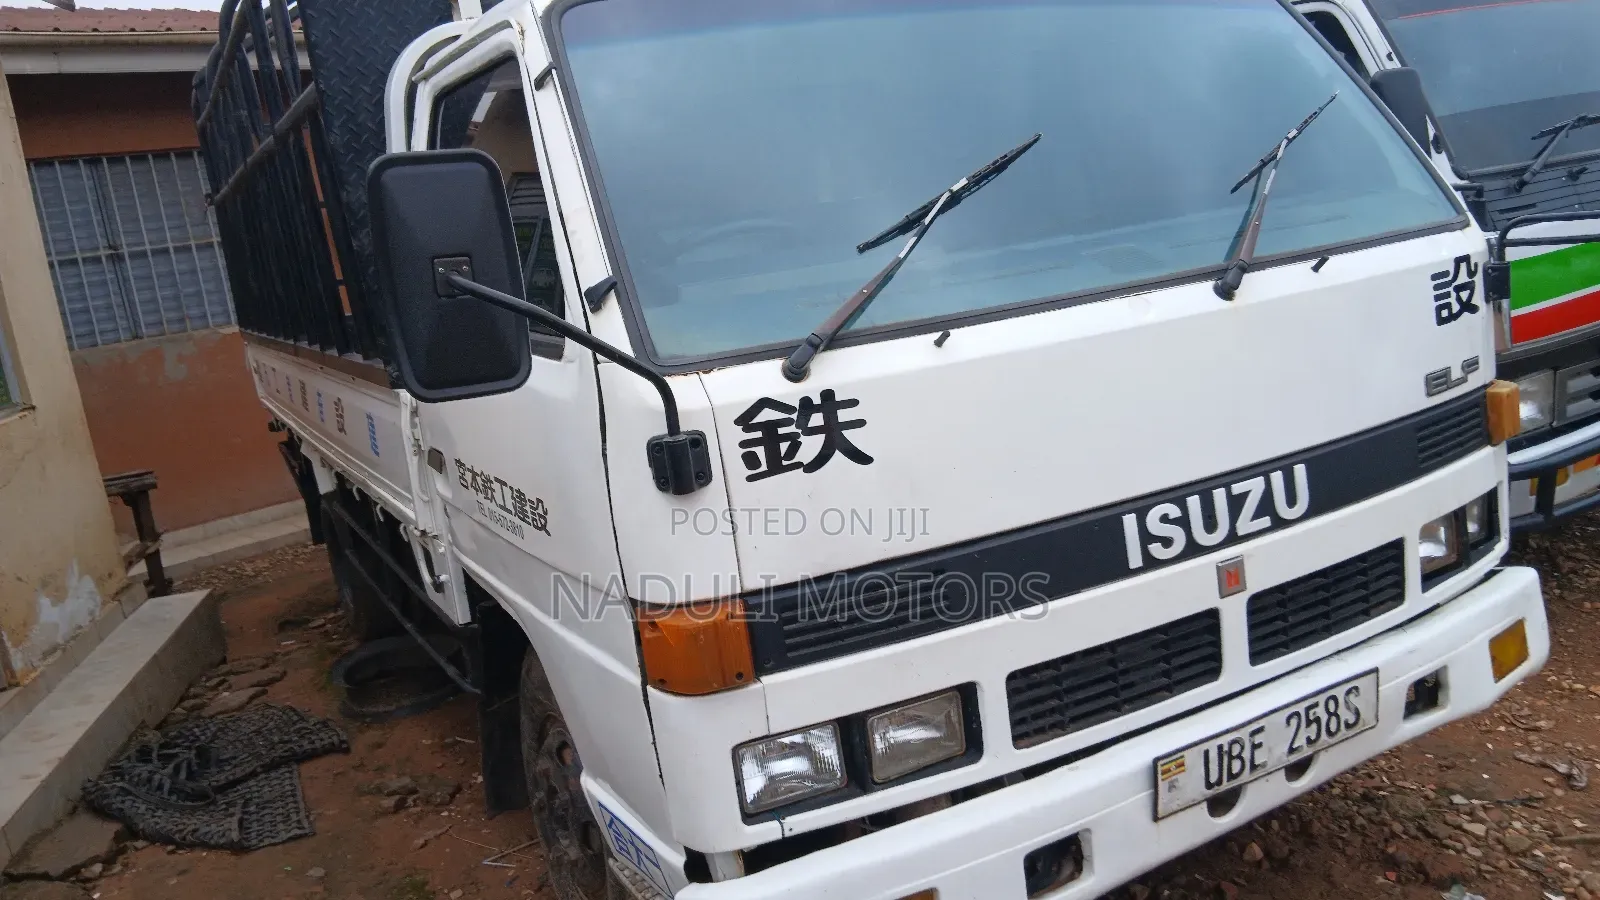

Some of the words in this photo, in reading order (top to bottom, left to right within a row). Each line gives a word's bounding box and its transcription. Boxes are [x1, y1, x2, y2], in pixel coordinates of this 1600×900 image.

[1430, 253, 1480, 326] 設
[1425, 355, 1480, 398] ELF
[733, 388, 875, 483] 鉄
[1121, 463, 1310, 570] ISUZU
[1203, 725, 1269, 791] UBE
[1285, 684, 1361, 757] 258S
